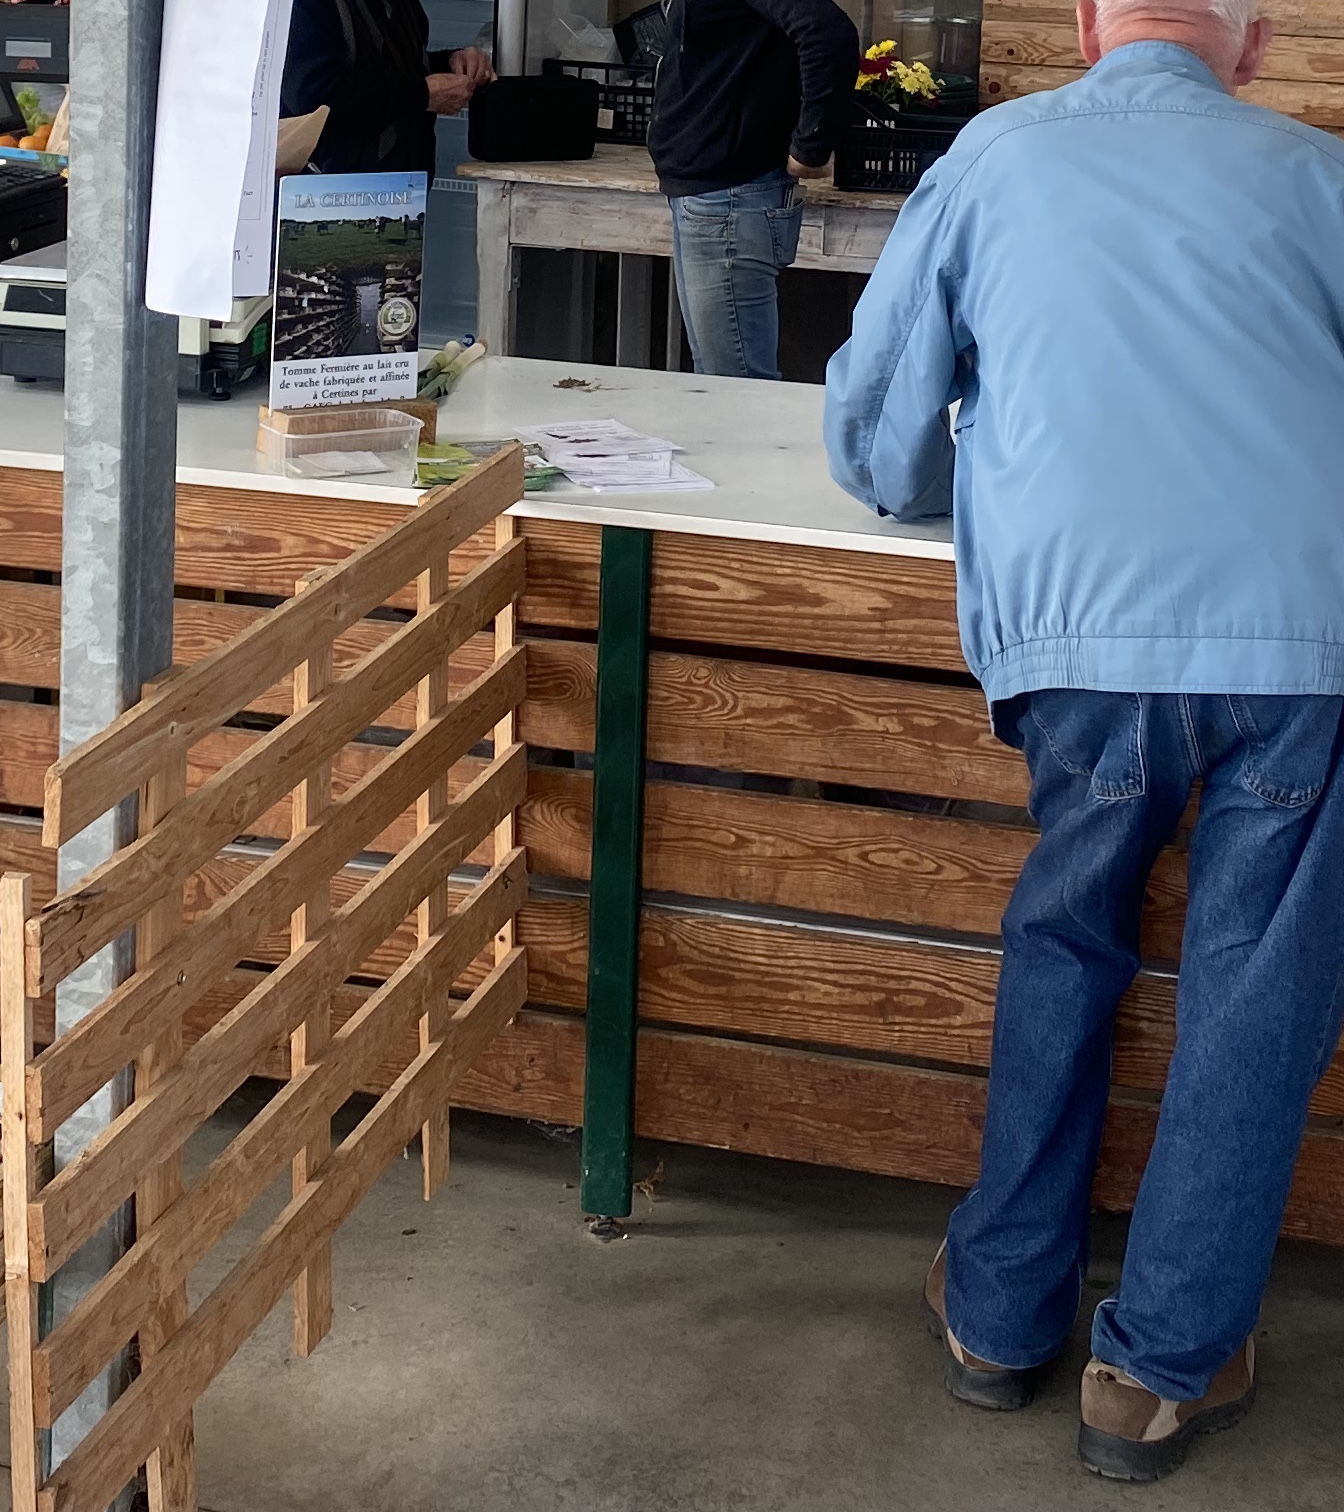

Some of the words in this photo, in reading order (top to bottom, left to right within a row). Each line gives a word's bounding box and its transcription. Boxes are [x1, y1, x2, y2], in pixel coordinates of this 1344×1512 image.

[294, 194, 316, 208] LA
[320, 190, 413, 208] CERTINOISE
[282, 366, 317, 376] Tomme
[320, 362, 360, 373] Fermière
[377, 359, 392, 369] lait
[395, 360, 409, 368] cru
[279, 380, 291, 389] de
[294, 378, 320, 388] vache
[323, 375, 365, 387] fabriquée
[368, 374, 377, 383] et
[380, 371, 410, 382] affinée
[312, 391, 318, 399] à
[321, 389, 359, 399] Certines
[362, 388, 378, 398] par
